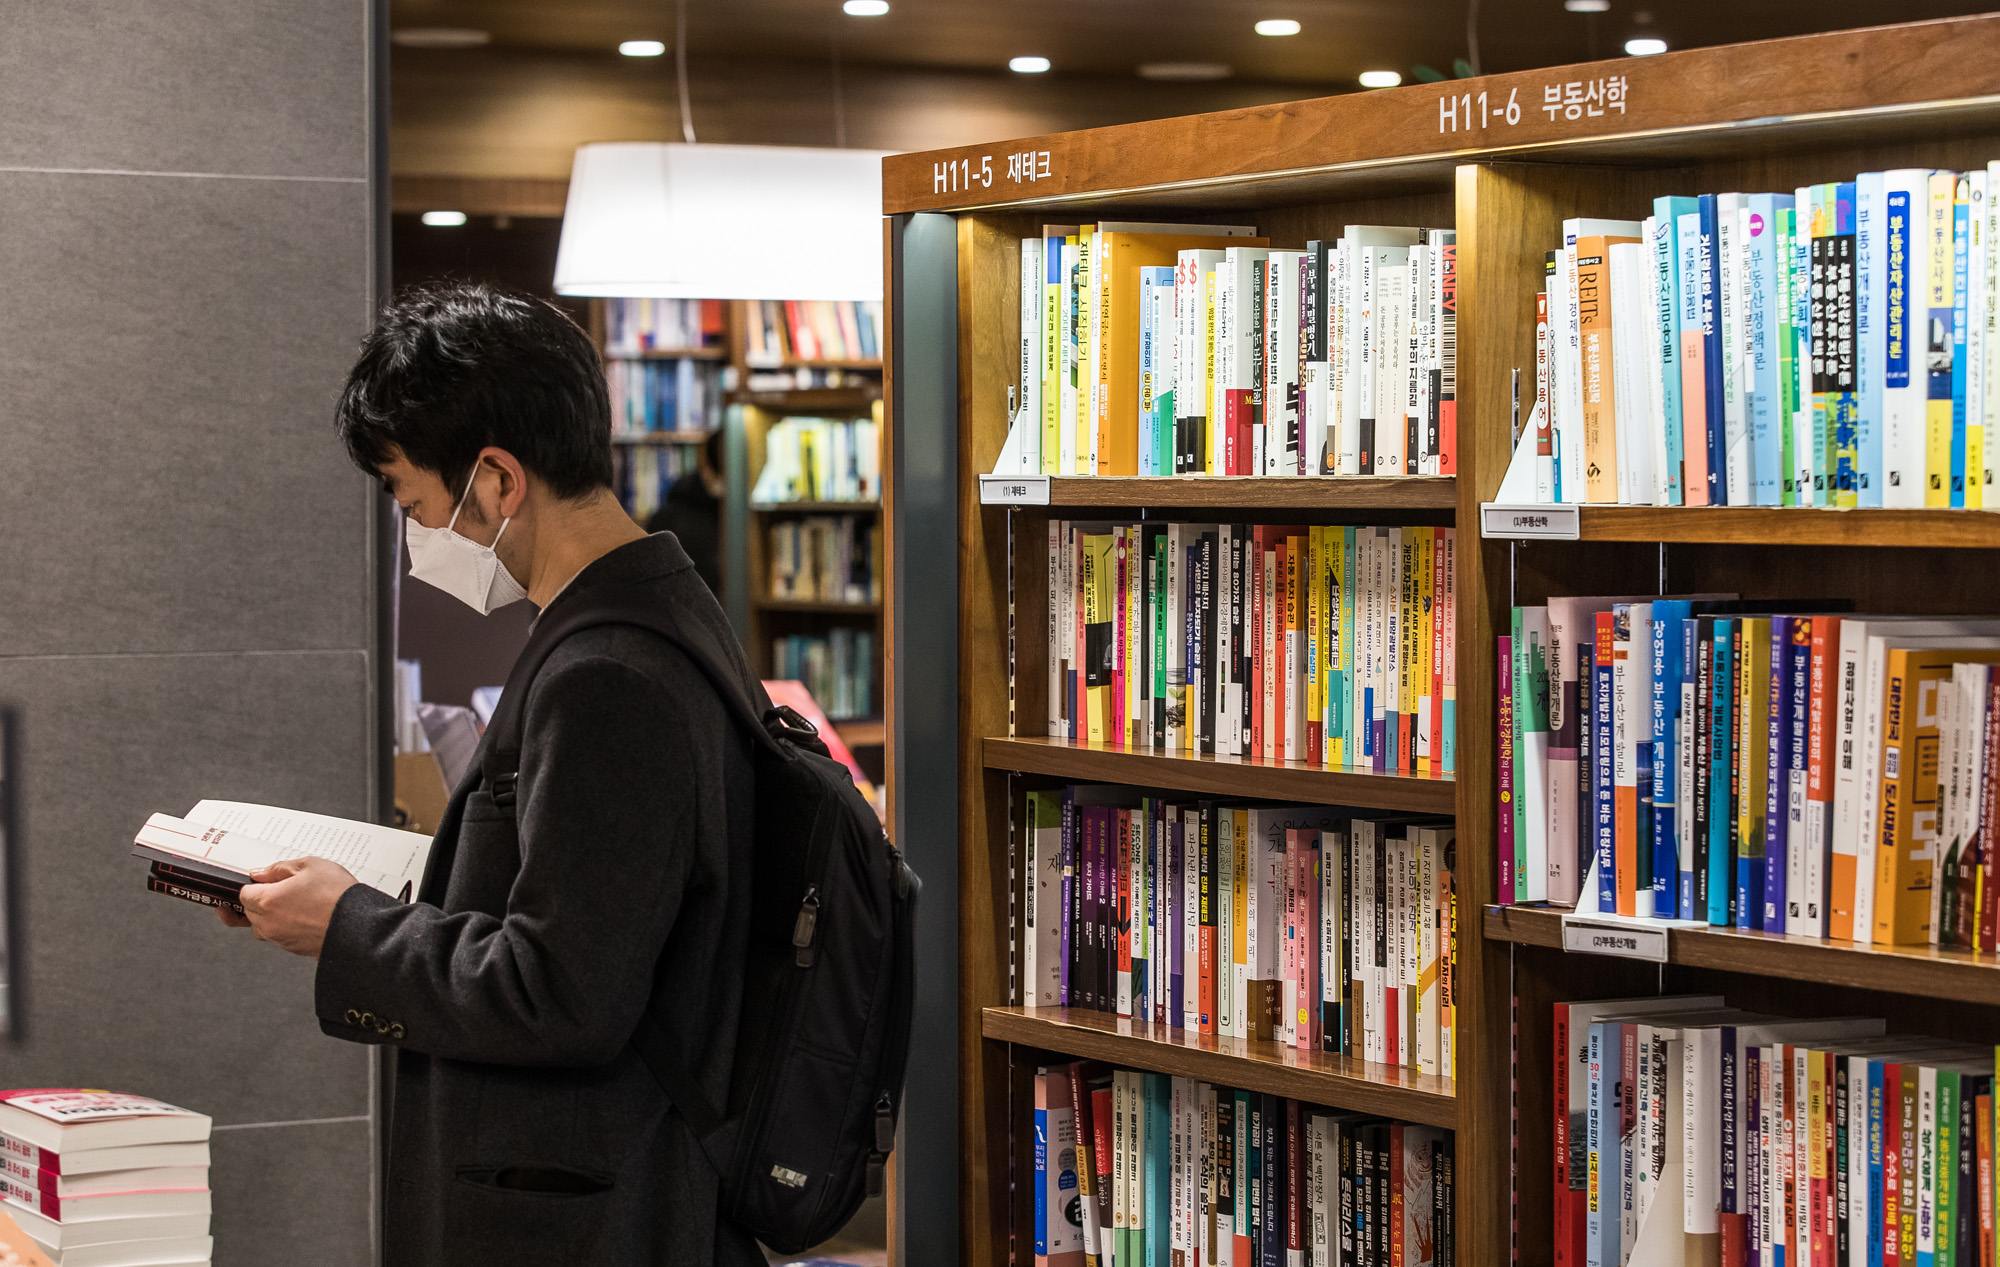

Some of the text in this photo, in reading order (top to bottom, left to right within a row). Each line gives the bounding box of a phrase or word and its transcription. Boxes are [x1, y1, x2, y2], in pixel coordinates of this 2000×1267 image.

[1438, 75, 1628, 135] H11-6 부동산학
[933, 151, 1052, 194] H11-5 재테크
[1442, 244, 1456, 311] MONEY
[1684, 247, 1696, 320] 부동산금융법
[1700, 233, 1713, 336] 거시경제와 부동산
[1777, 233, 1788, 324] 부동산금융론
[1858, 210, 1870, 334] 부동산개발론
[1889, 215, 1904, 359] 부동산자산관리론
[1079, 241, 1088, 361] 재테크 시작하기
[1568, 253, 1578, 349] 부동산 경제학
[1659, 241, 1672, 364] 부동산금융론
[1751, 250, 1765, 371] 부동산정책론
[1811, 264, 1824, 375] 부동산정책론
[1825, 264, 1838, 376] 부동산투자론
[1838, 263, 1851, 386] 부동산감정평가론
[1270, 331, 1278, 363] 부부의
[1579, 272, 1601, 404] REITs 부동산투자신탁
[1011, 486, 1026, 496] 재테크
[1513, 516, 1548, 527] (1)부동산학
[1201, 541, 1209, 609] 백만장자 메신저
[1402, 544, 1411, 603] 개인투자조합
[1220, 586, 1229, 636] 부자경제학
[1331, 585, 1340, 669] 난생처음 재테크
[1389, 616, 1397, 672] 태양광발전소
[1550, 639, 1561, 727] 부동산학개론
[1581, 655, 1589, 709] 부동산금융
[1599, 672, 1610, 723] 토지개발과
[1812, 655, 1822, 693] 부동산
[1843, 662, 1856, 735] 정비사업의
[1500, 694, 1512, 769] 부동산경제학의
[1615, 666, 1625, 779] 부동산개발론
[1653, 682, 1665, 737] 부동산
[1698, 709, 1706, 733] 알아야
[1713, 650, 1724, 761] 부동산PF 개발사업법
[1792, 655, 1805, 785] 부동산개발금융의
[1810, 697, 1822, 761] 개발사업의
[1581, 713, 1589, 757] 프로젝트
[1600, 726, 1611, 787] 리모델링으로
[1698, 736, 1706, 764] 부동산
[1882, 677, 1901, 847] 대한민국 도시재생
[1600, 790, 1610, 800] 돈
[1653, 743, 1665, 797] 개발론
[1697, 767, 1706, 796] 투자가
[1600, 803, 1611, 824] 버는
[1119, 860, 1127, 892] 페이크
[1187, 887, 1196, 928] 프리덤
[1593, 936, 1636, 950] (2)부동산개발
[1624, 1085, 1632, 1115] 이틀에
[1652, 1034, 1660, 1181] 재개발 재건축 지금 사도 될까요?
[1723, 1053, 1735, 1189] 주택임대사업자의 모든 것
[1797, 1101, 1805, 1138] 잘나가는
[1870, 1086, 1880, 1118] 부동산
[1315, 1131, 1322, 1150] 서른
[1624, 1117, 1632, 1147] 끝내는
[1200, 1154, 1208, 1188] 주식의
[1252, 1150, 1260, 1176] 재테크
[1315, 1164, 1323, 1204] 백만장자
[1797, 1143, 1805, 1202] 공인중개사의
[1886, 1150, 1897, 1190] 수수료
[1252, 1178, 1260, 1205] 불변의
[1252, 1207, 1260, 1226] 법칙
[1341, 1177, 1352, 1252] 돈워리스쿨
[1886, 1196, 1897, 1225] 10배
